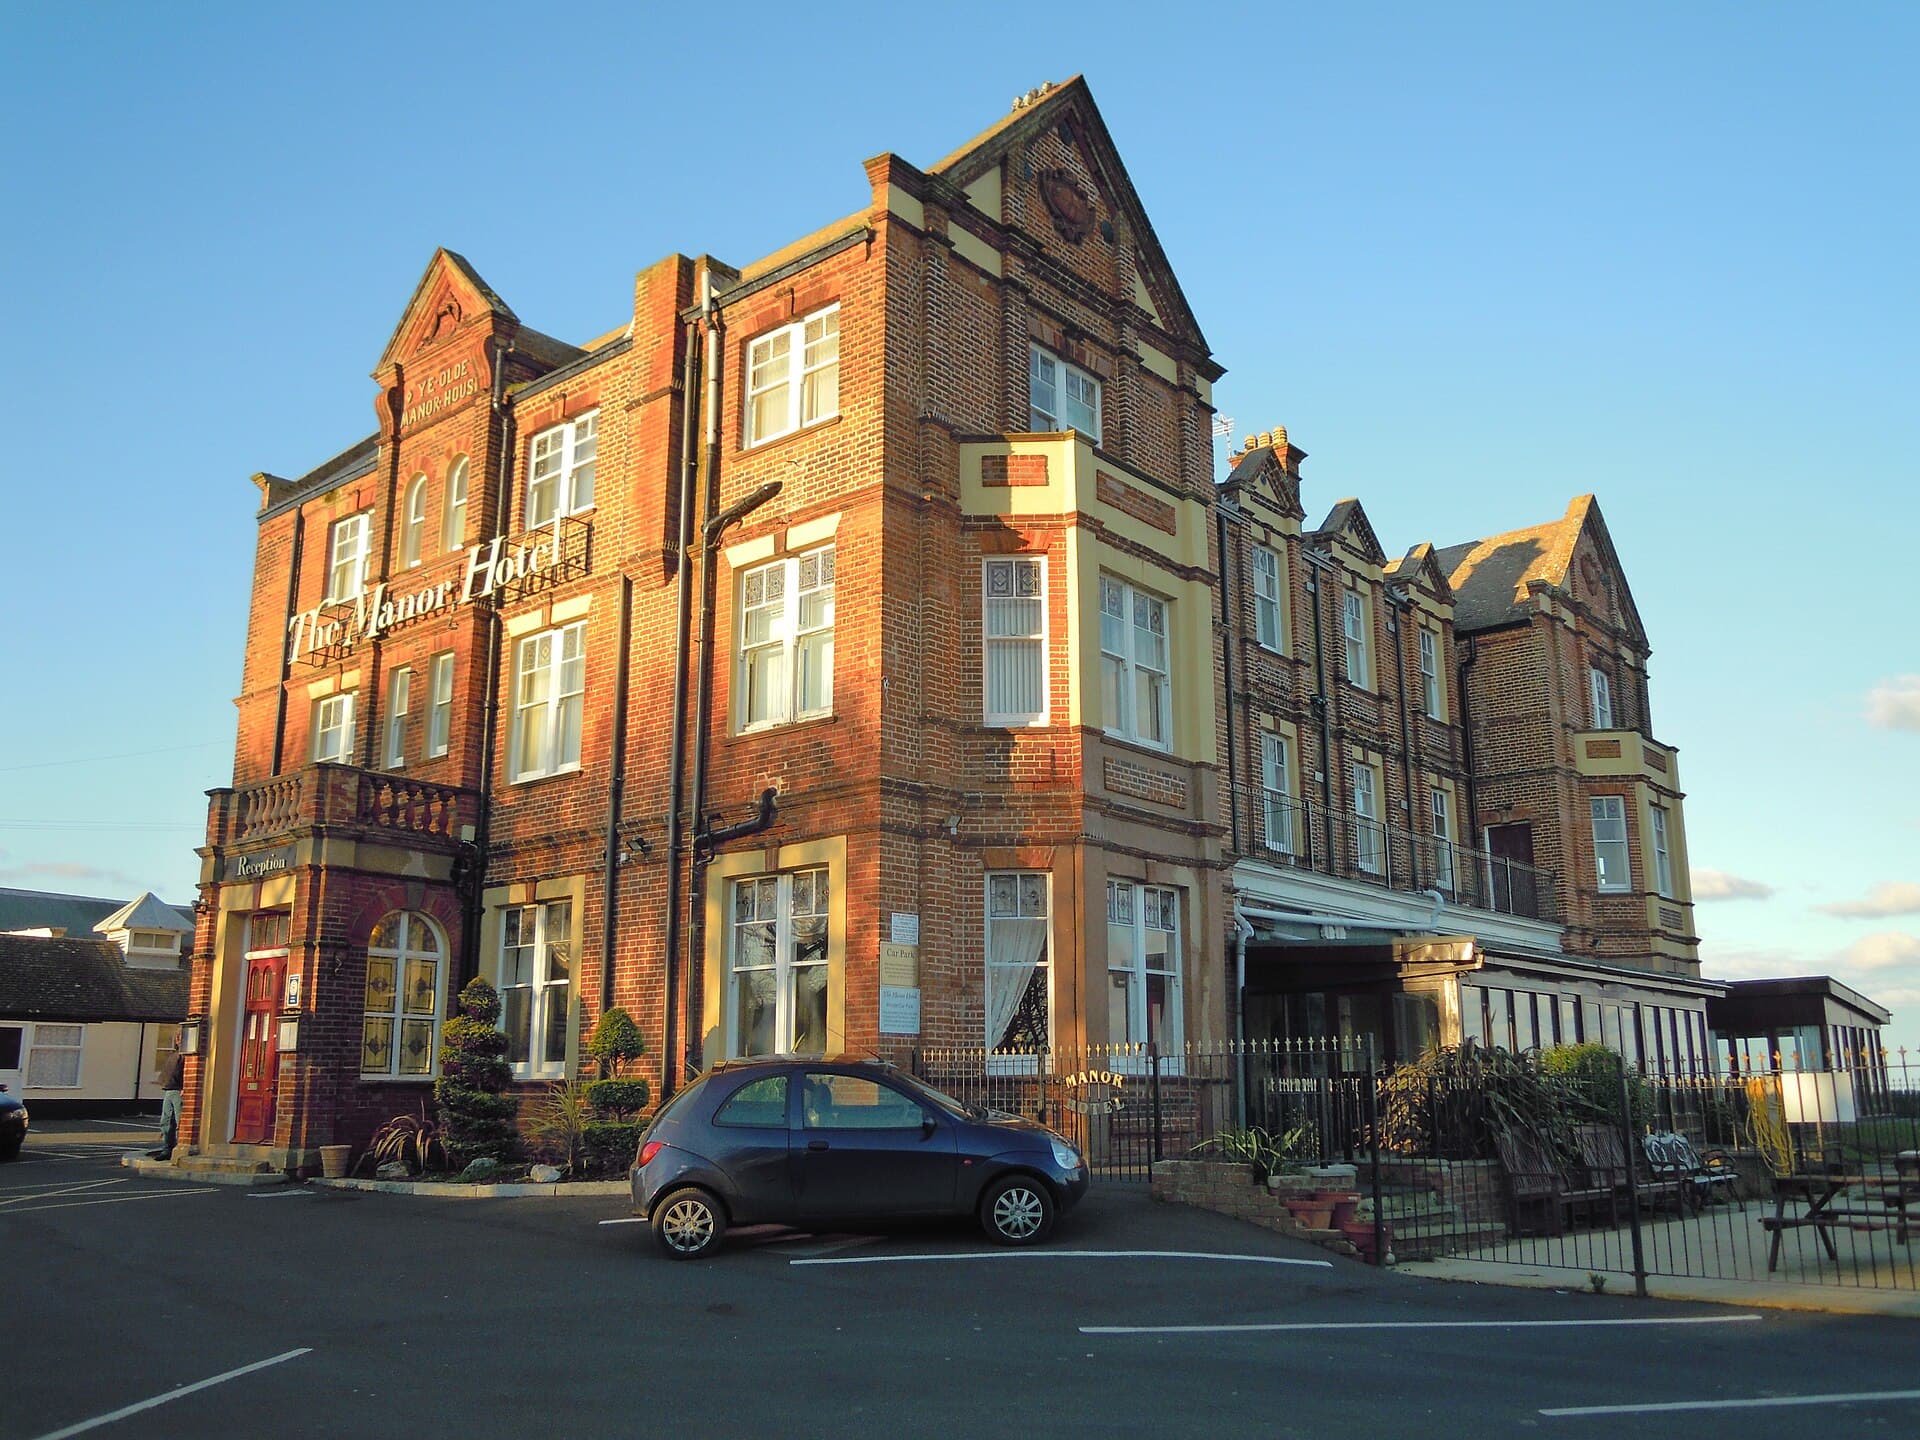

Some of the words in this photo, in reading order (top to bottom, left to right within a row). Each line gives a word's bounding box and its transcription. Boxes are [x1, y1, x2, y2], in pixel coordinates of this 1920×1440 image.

[288, 597, 341, 664] The
[342, 583, 453, 647] Manor
[458, 508, 562, 605] Hotel
[237, 853, 286, 876] Reception
[887, 948, 899, 957] Car
[1065, 1070, 1124, 1089] MANOR
